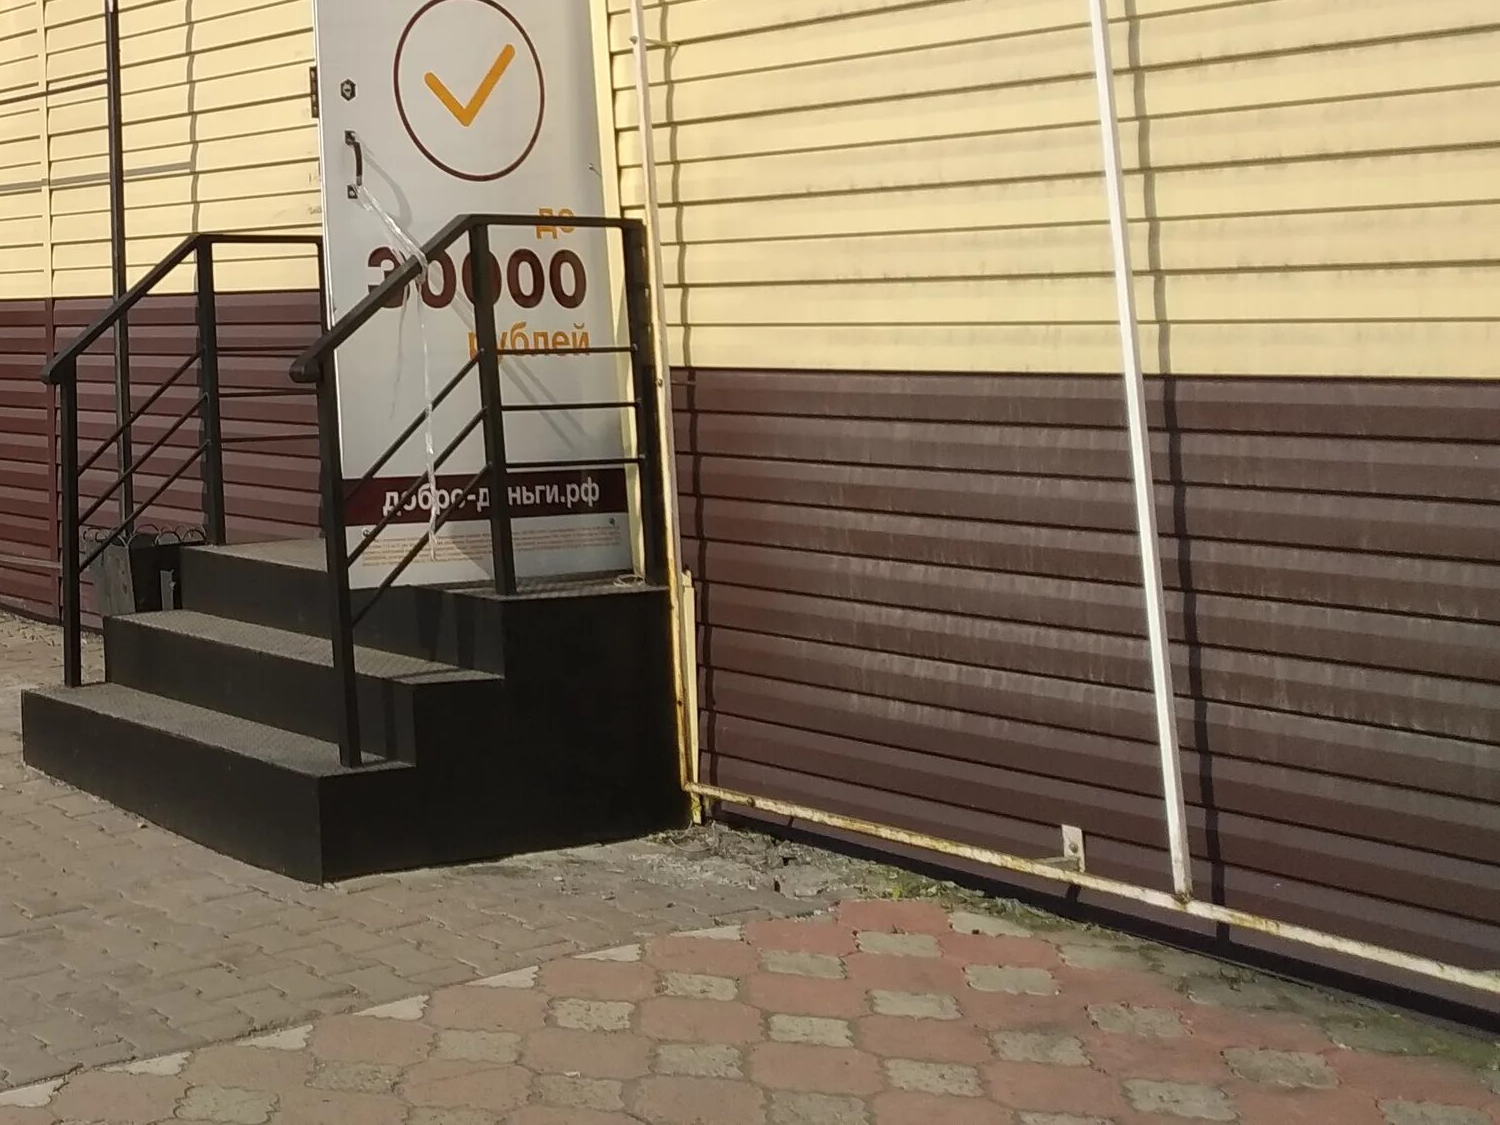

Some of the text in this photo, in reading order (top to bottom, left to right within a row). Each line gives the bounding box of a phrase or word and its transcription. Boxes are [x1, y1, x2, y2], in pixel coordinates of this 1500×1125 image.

[536, 207, 575, 239] до
[367, 245, 588, 309] 30000
[382, 476, 601, 518] добро-дньги.рф
